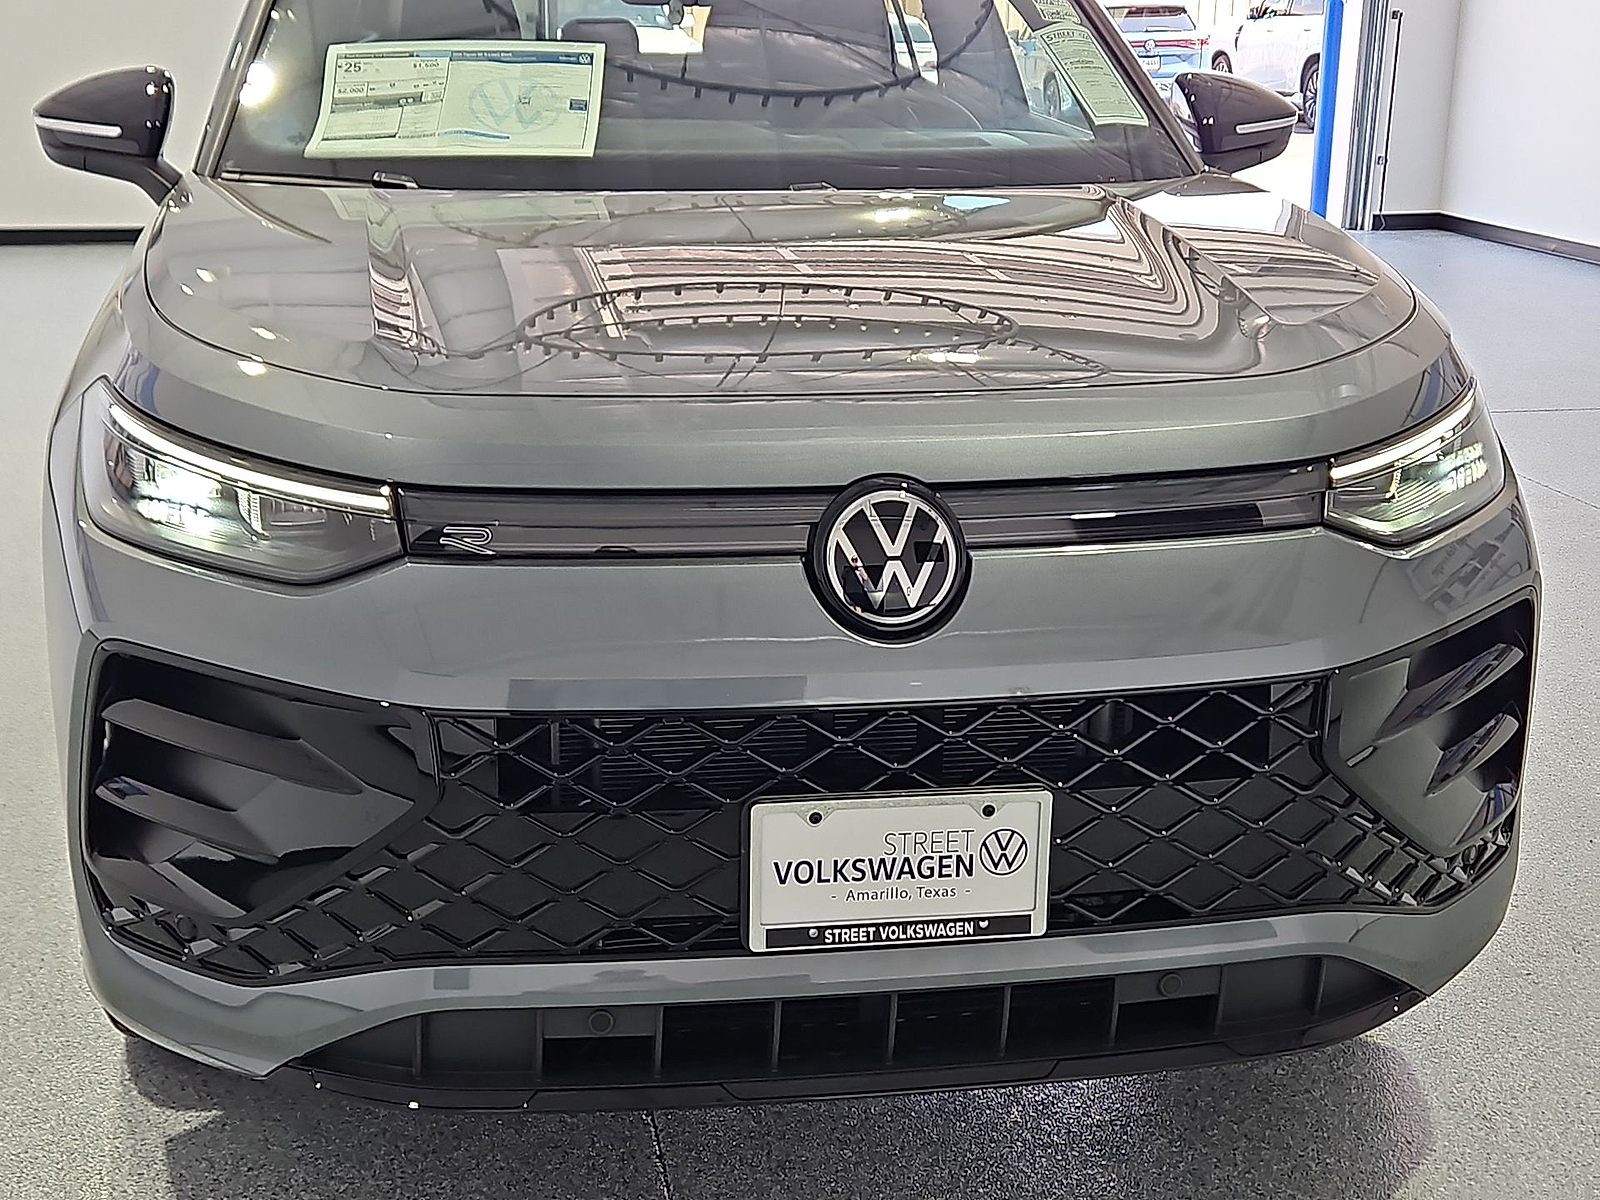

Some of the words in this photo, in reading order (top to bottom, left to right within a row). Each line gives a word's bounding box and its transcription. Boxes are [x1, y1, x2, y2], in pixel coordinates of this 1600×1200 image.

[344, 62, 362, 73] 25
[884, 829, 976, 857] STREET
[773, 853, 975, 885] VOLKSWAGEN
[845, 886, 913, 903] Amarillo,
[916, 885, 956, 900] Texas
[824, 925, 877, 944] STREET
[879, 921, 975, 940] VOLKSWAGEN
